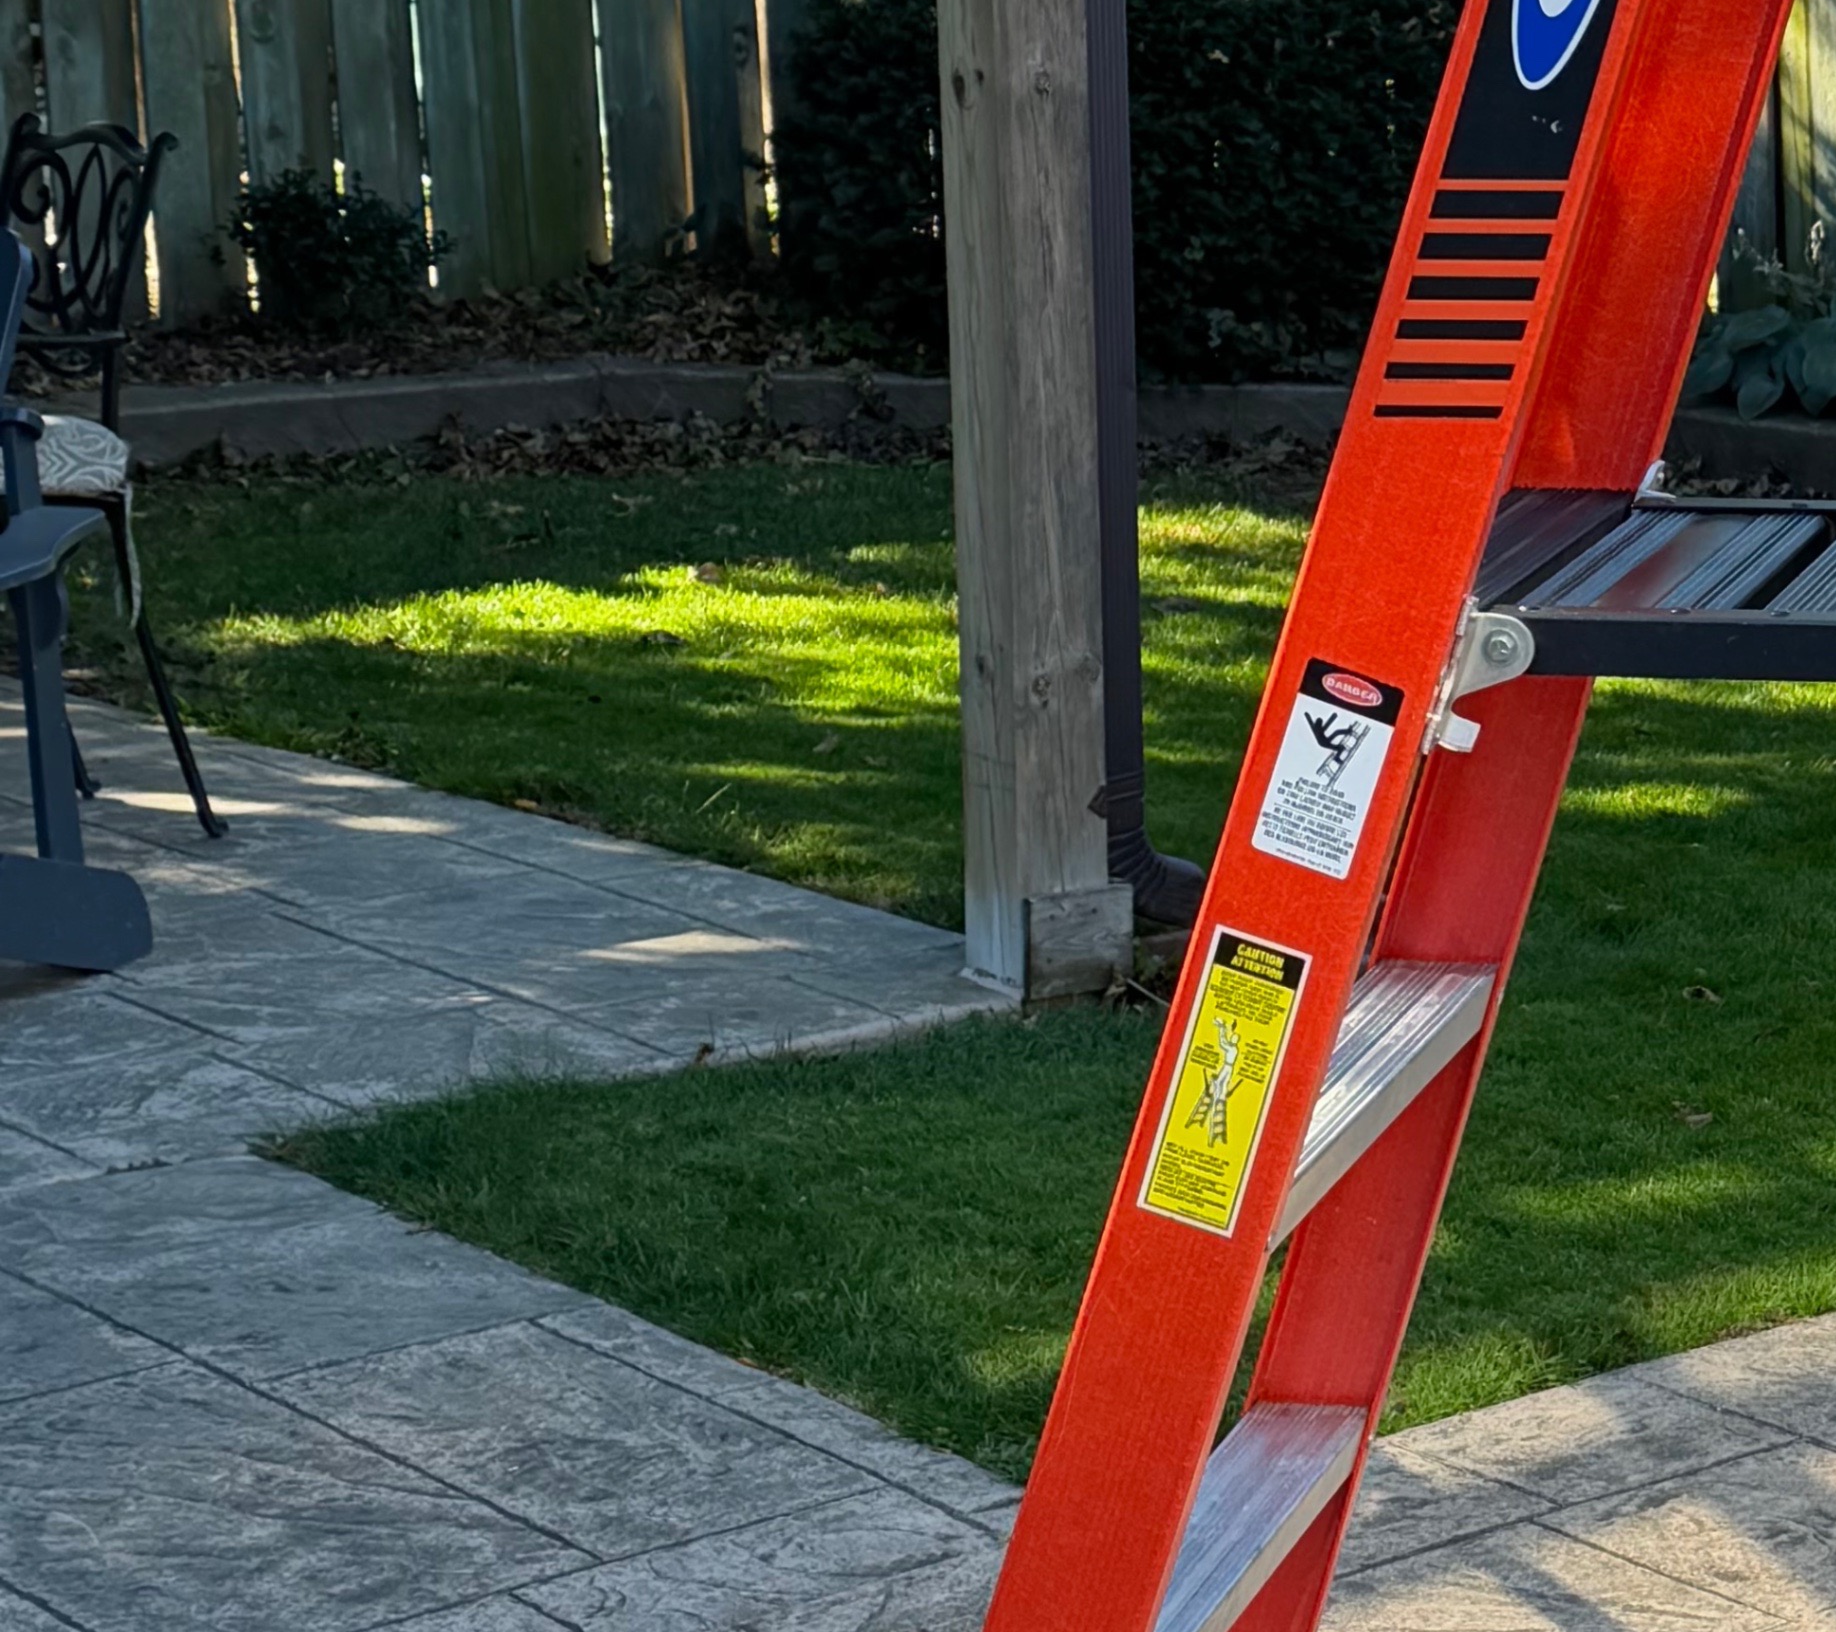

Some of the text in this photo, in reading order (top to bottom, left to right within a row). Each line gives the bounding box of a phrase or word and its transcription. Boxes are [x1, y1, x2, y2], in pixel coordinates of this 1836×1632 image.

[1326, 677, 1377, 704] DANGER
[1230, 955, 1284, 981] ATTENTION
[1237, 943, 1285, 969] CAUTION
